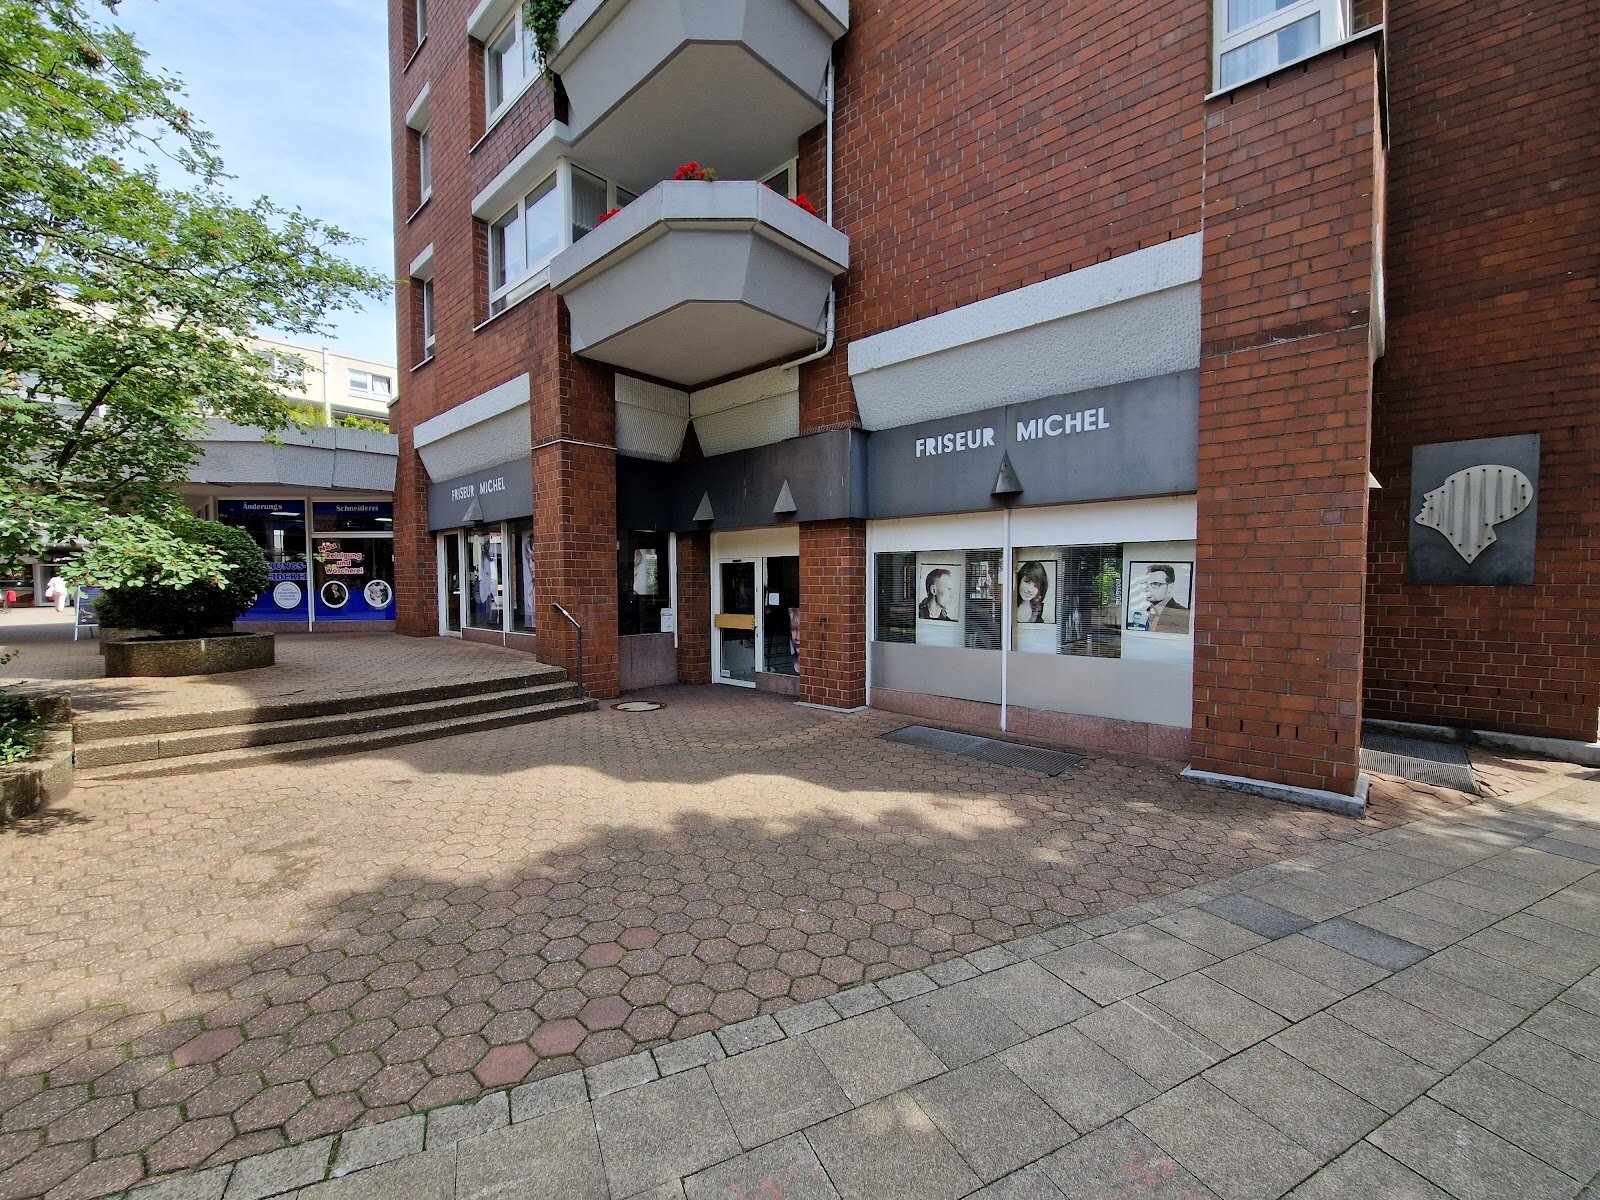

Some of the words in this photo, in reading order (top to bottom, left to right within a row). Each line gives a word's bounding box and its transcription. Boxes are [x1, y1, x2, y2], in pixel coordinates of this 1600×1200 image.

[915, 427, 995, 458] FRISEUR
[1016, 406, 1110, 442] MICHEL
[451, 484, 475, 502] FRISEUR
[479, 477, 506, 495] MICHEL
[243, 502, 282, 511] Änderungs
[325, 552, 363, 560] Reinigung
